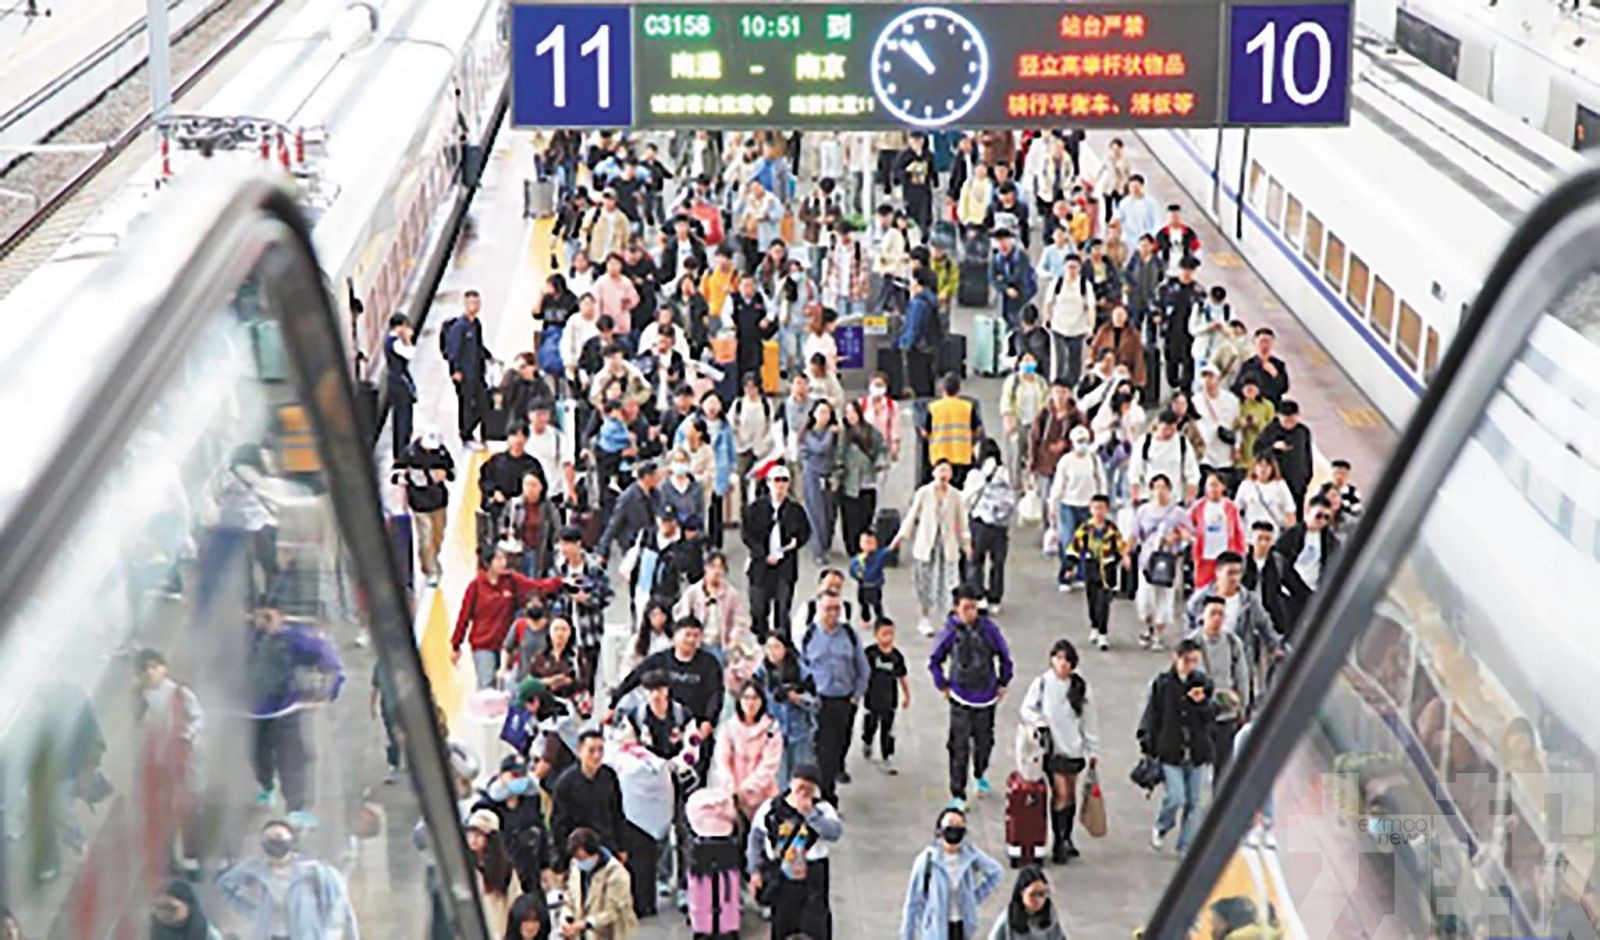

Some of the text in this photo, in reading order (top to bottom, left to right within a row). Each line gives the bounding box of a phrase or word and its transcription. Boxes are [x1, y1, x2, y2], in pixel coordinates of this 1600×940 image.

[740, 15, 801, 37] 10:51
[1060, 14, 1145, 38] 站台严禁
[535, 24, 610, 109] 11
[1018, 53, 1186, 77] 竖立高举杆状物品
[1245, 21, 1332, 106] 10
[1008, 92, 1195, 116] 骑行平衡车、滑板等
